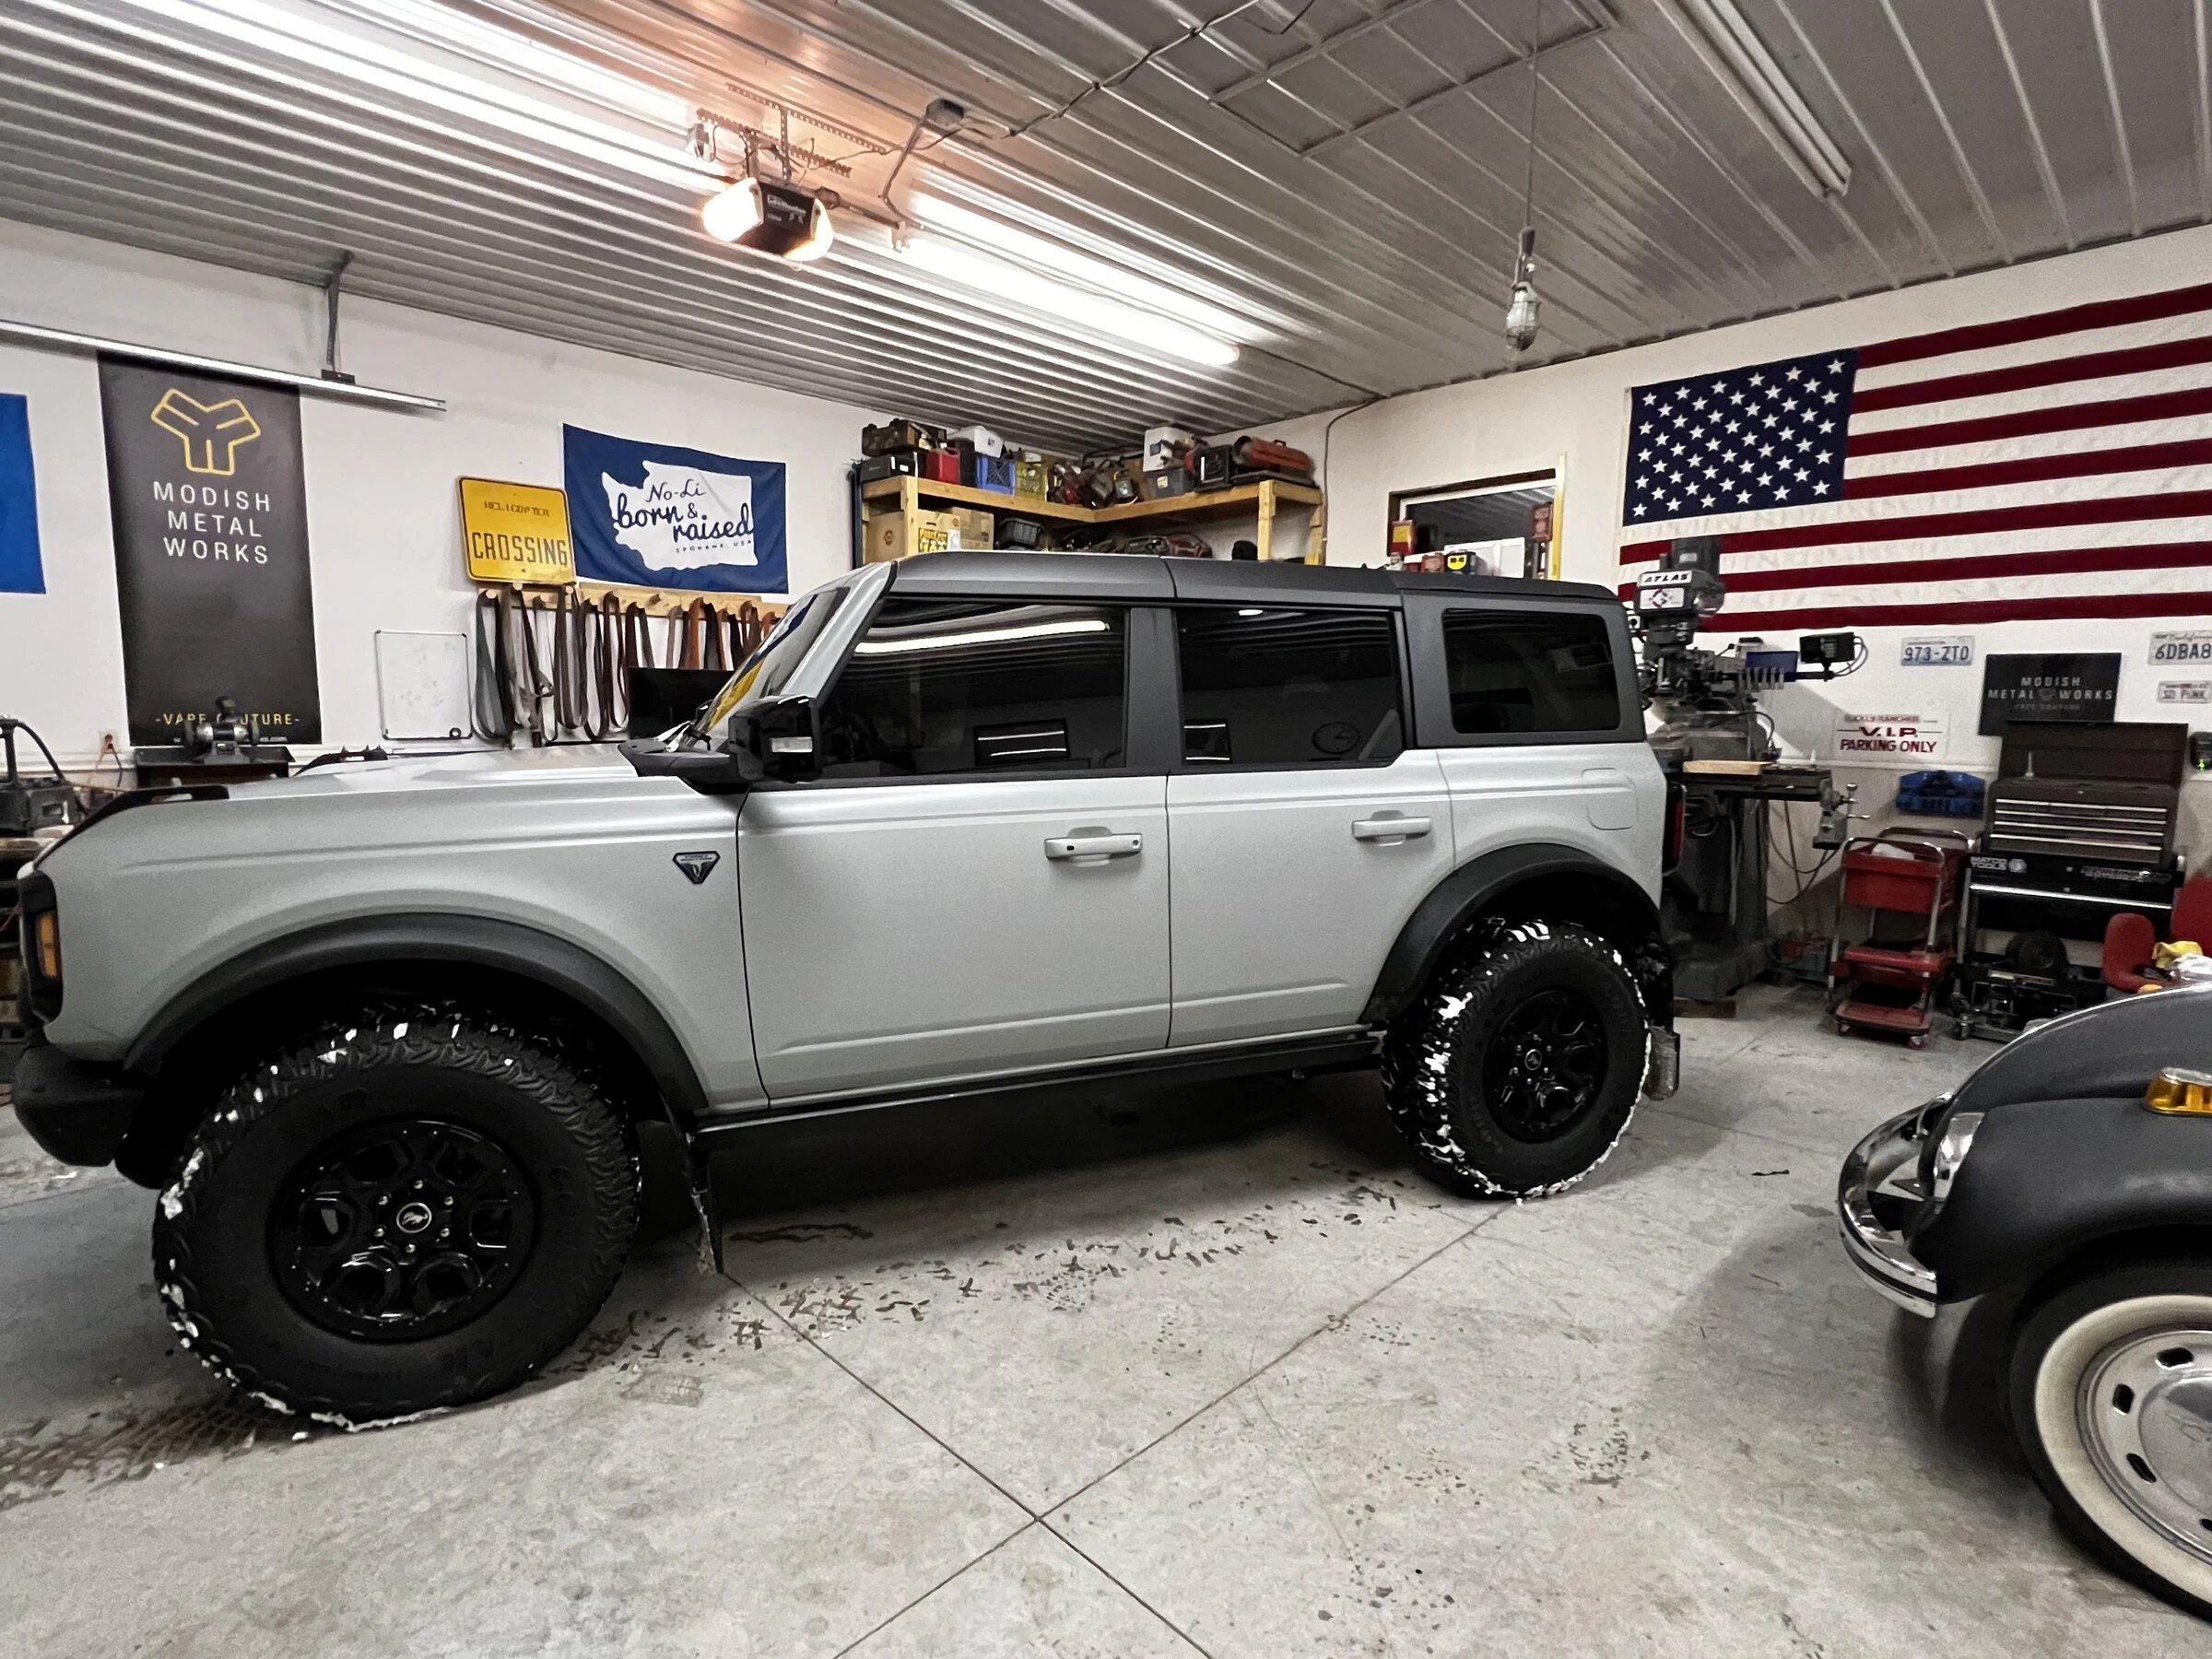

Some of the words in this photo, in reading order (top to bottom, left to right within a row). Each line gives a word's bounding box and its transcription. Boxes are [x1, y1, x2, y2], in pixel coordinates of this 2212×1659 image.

[153, 480, 270, 512] MODISH
[645, 478, 707, 502] No-Li
[484, 500, 550, 517] HELICOPTER
[612, 493, 684, 528] born
[687, 502, 699, 519] &
[168, 510, 262, 537] METAL
[673, 502, 754, 543] raised
[163, 536, 268, 564] WORKS
[472, 531, 568, 567] CROSSING
[733, 539, 752, 547] USA
[1644, 573, 1688, 582] ATLAS
[1988, 688, 2035, 700] METAL
[2059, 689, 2113, 700] WORKS
[2020, 677, 2081, 687] MODISH
[1840, 739, 1897, 752] PARKING
[1900, 740, 1937, 753] ONLY
